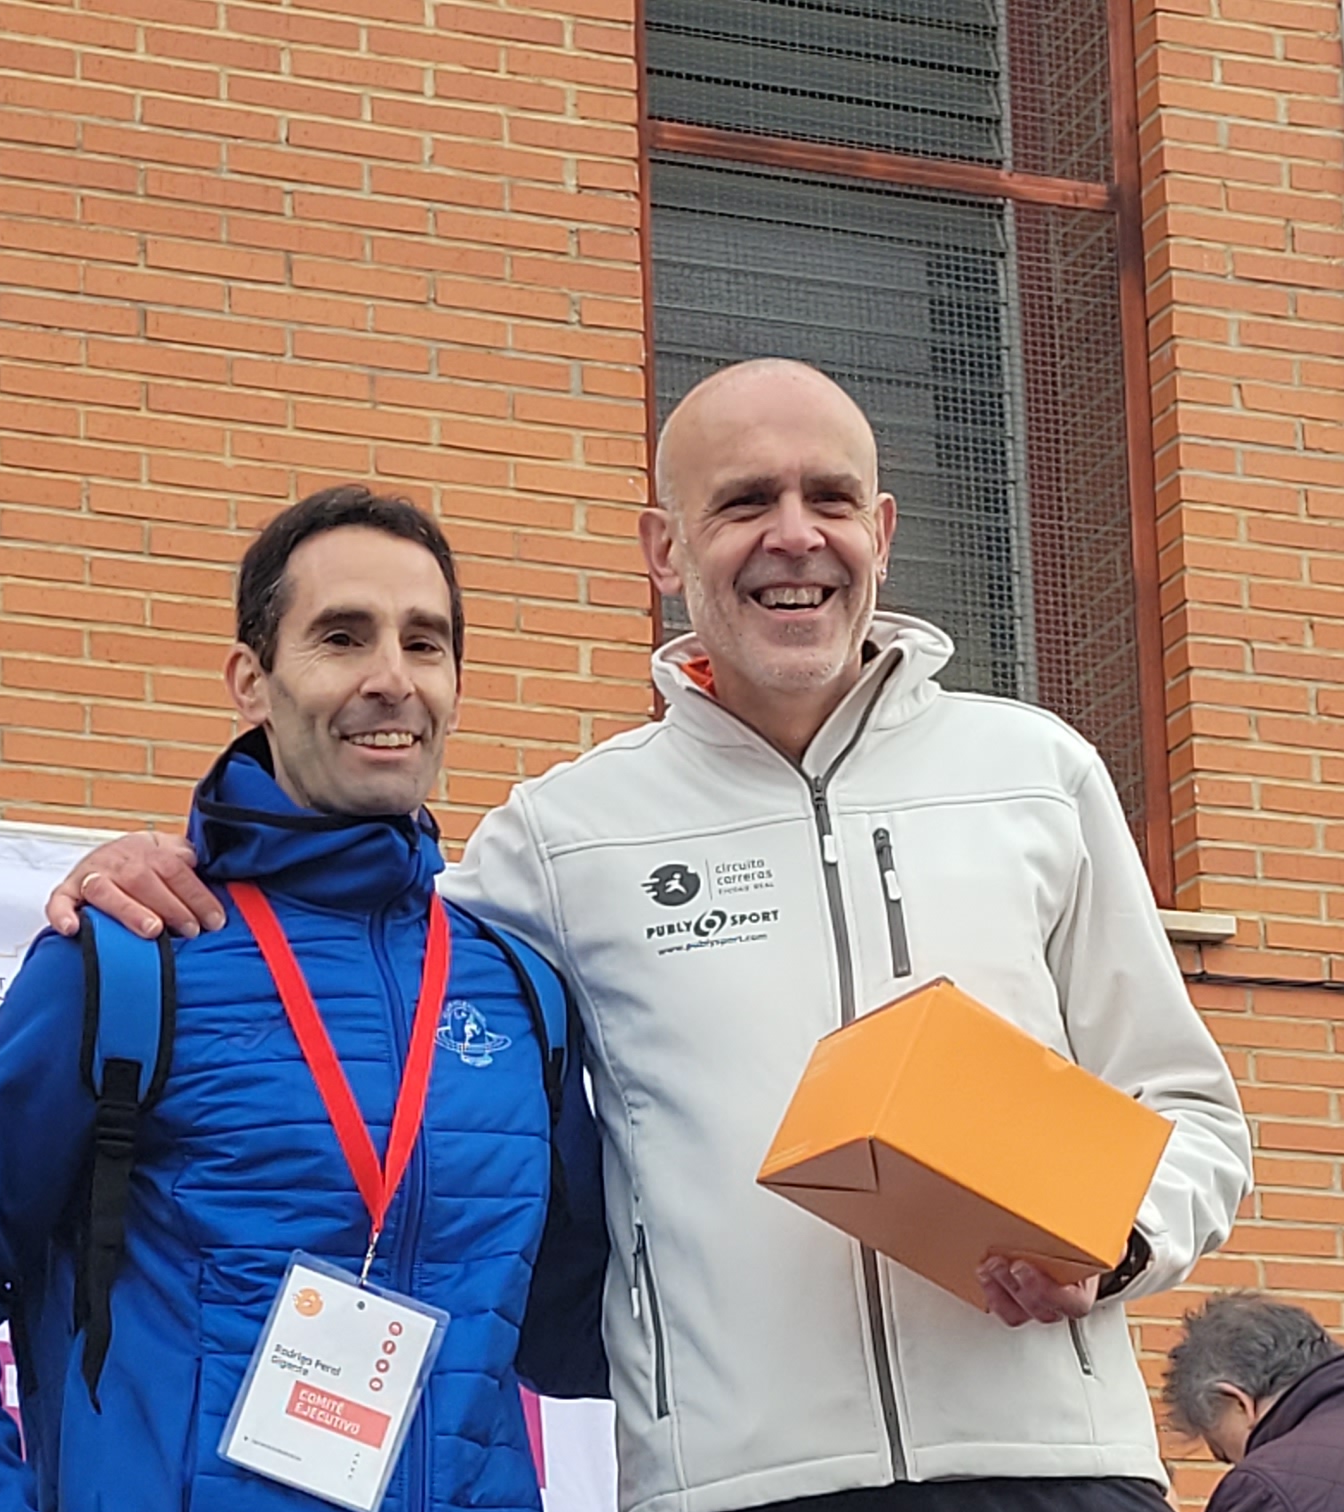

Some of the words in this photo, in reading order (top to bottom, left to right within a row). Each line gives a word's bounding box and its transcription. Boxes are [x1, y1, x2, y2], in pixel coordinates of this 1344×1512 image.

[715, 859, 765, 874] circuito
[717, 870, 773, 886] carreras
[646, 920, 693, 940] PUBLY
[730, 909, 780, 926] SPORT
[293, 1401, 361, 1435] EJECUTIVO
